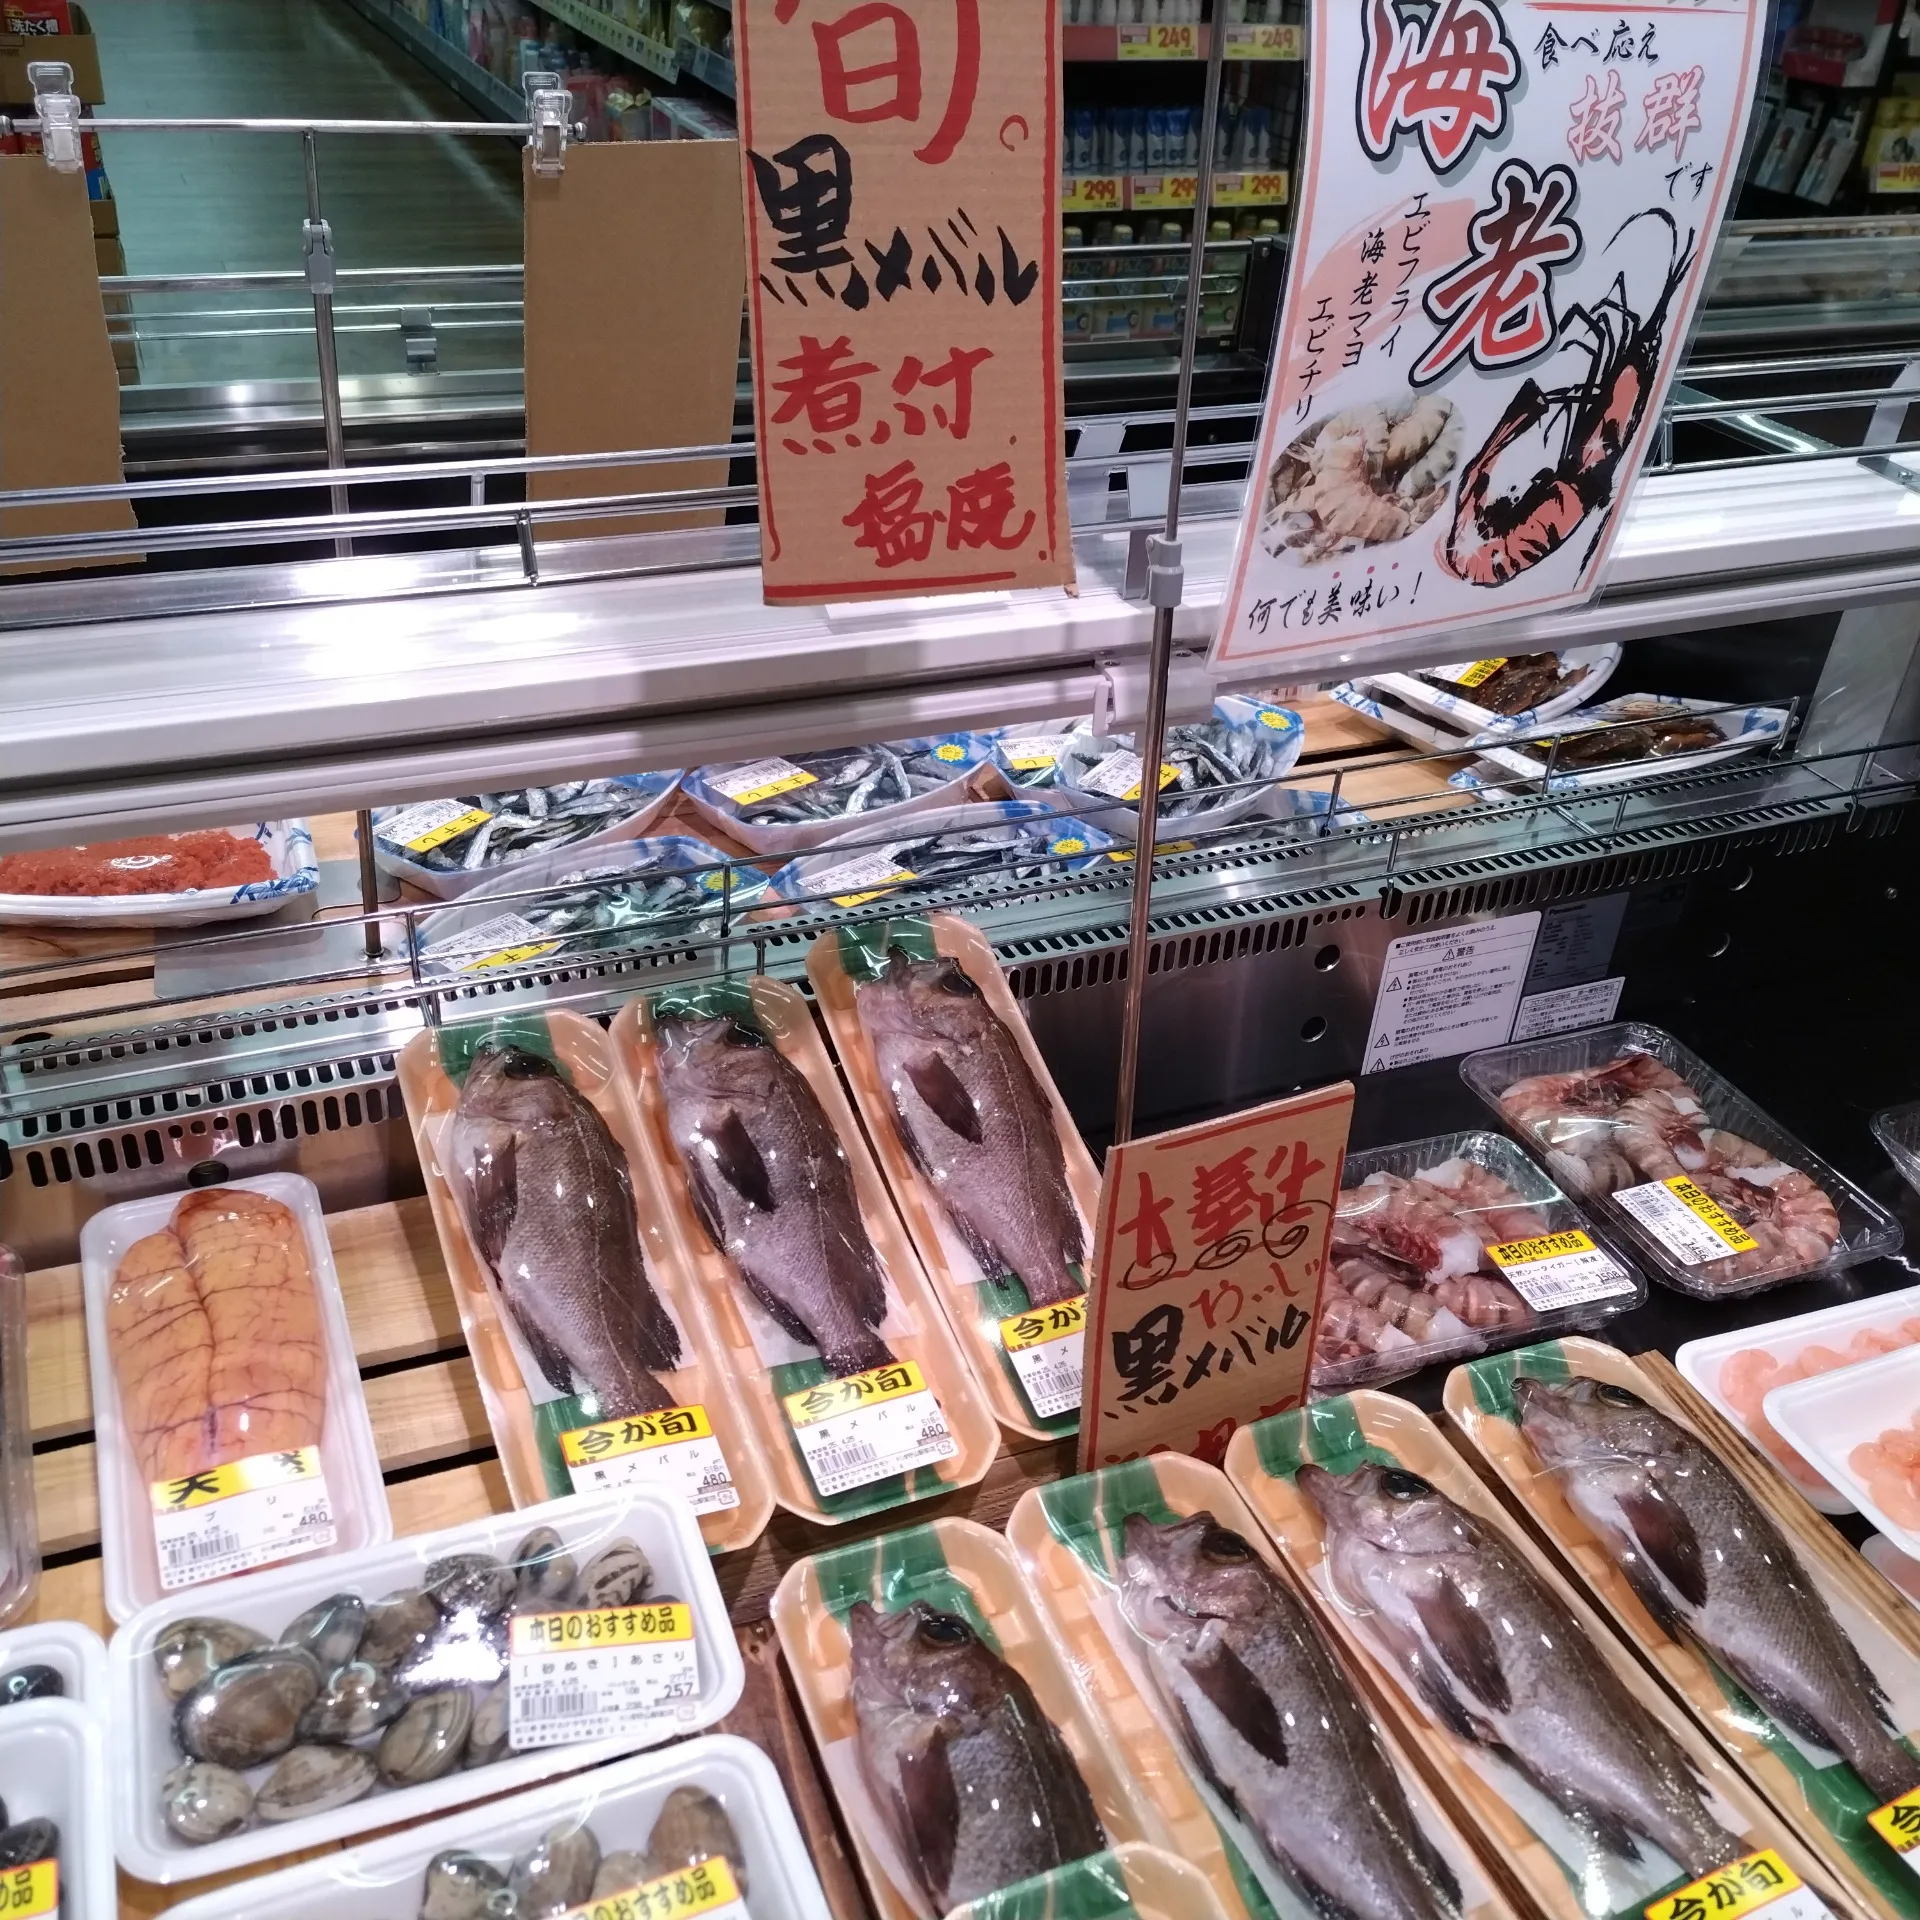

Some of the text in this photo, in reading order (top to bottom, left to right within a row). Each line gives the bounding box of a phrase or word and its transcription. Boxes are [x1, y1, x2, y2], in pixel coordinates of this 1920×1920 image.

[1158, 27, 1191, 48] 249
[1261, 30, 1294, 49] 249
[1534, 19, 1660, 71] 食べ応え
[1566, 64, 1704, 167] 抜群
[1084, 180, 1116, 200] 299
[1251, 176, 1282, 195] 299
[1665, 160, 1714, 201] です
[746, 133, 1039, 312] 黒メバル
[1380, 192, 1432, 358] エビフライ
[1341, 227, 1387, 368] 海老マヨ
[1295, 296, 1336, 426] エビチリ
[1673, 1182, 1751, 1245] 本日のおすすめ品
[1497, 1232, 1585, 1262] 本日のおすすめ品
[1012, 1297, 1090, 1340] 今が
[1103, 1303, 1312, 1420] 黒メバル
[799, 1366, 913, 1415] 今が旬
[577, 1410, 699, 1456] 今が旬
[818, 1403, 917, 1440] 黒メバル
[921, 1422, 945, 1439] 480
[593, 1450, 700, 1482] 黒メバル
[702, 1472, 728, 1488] 480
[299, 1511, 328, 1526] 480
[529, 1605, 677, 1643] 本日のおすすめ品
[663, 1681, 695, 1700] 257
[1669, 1858, 1784, 1920] 今が旬
